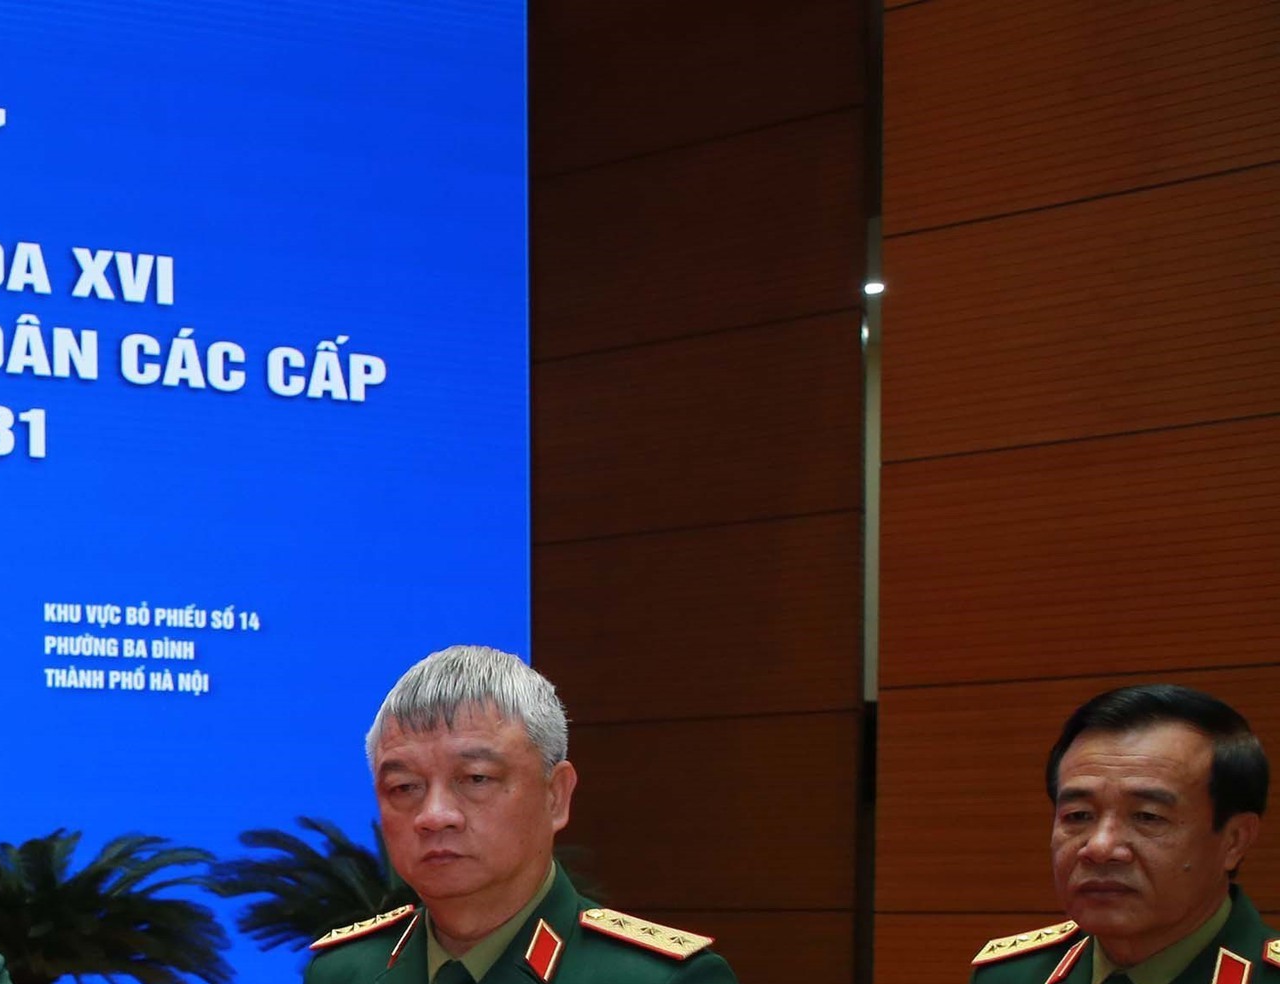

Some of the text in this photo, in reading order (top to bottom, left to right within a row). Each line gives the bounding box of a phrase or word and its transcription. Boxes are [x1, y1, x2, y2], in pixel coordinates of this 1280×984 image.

[72, 247, 174, 305] XVI
[121, 327, 246, 391] CÁC
[268, 335, 387, 402] CẤP
[44, 601, 260, 630] KHU VỰC BỎ PHIẾU SỐ 14
[44, 633, 195, 660] PHƯỜNG BA ĐÌNH
[44, 665, 209, 696] THÀNH PHỐ HÀ NỘI
